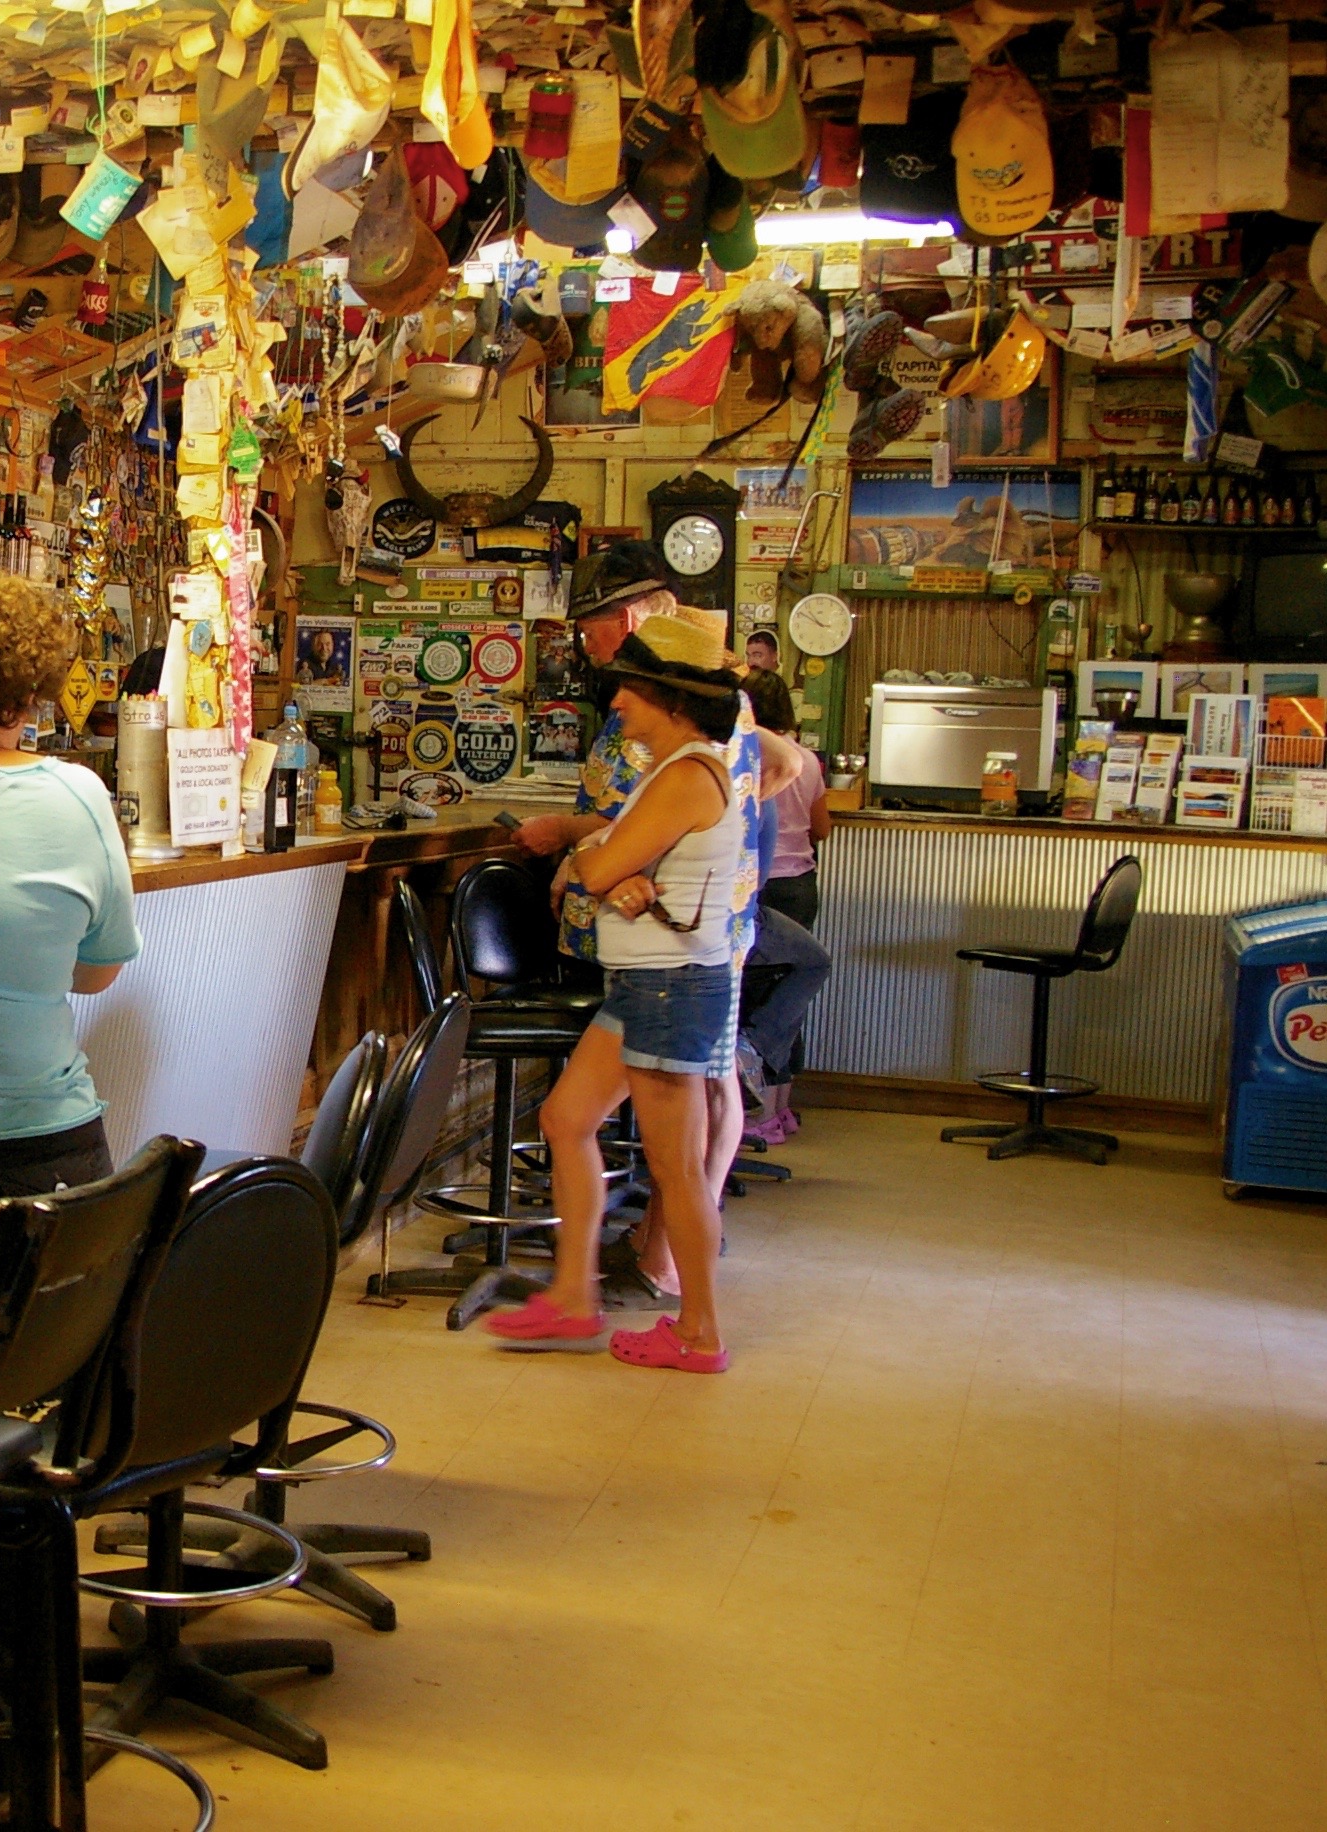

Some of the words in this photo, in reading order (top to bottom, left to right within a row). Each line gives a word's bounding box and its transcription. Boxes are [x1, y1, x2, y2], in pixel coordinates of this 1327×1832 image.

[861, 472, 905, 480] EXPORT
[957, 472, 1003, 480] DROUGH
[391, 642, 420, 650] FAKRO
[457, 733, 515, 750] COLD
[460, 750, 511, 761] FILTERED
[462, 763, 507, 782] BITTER
